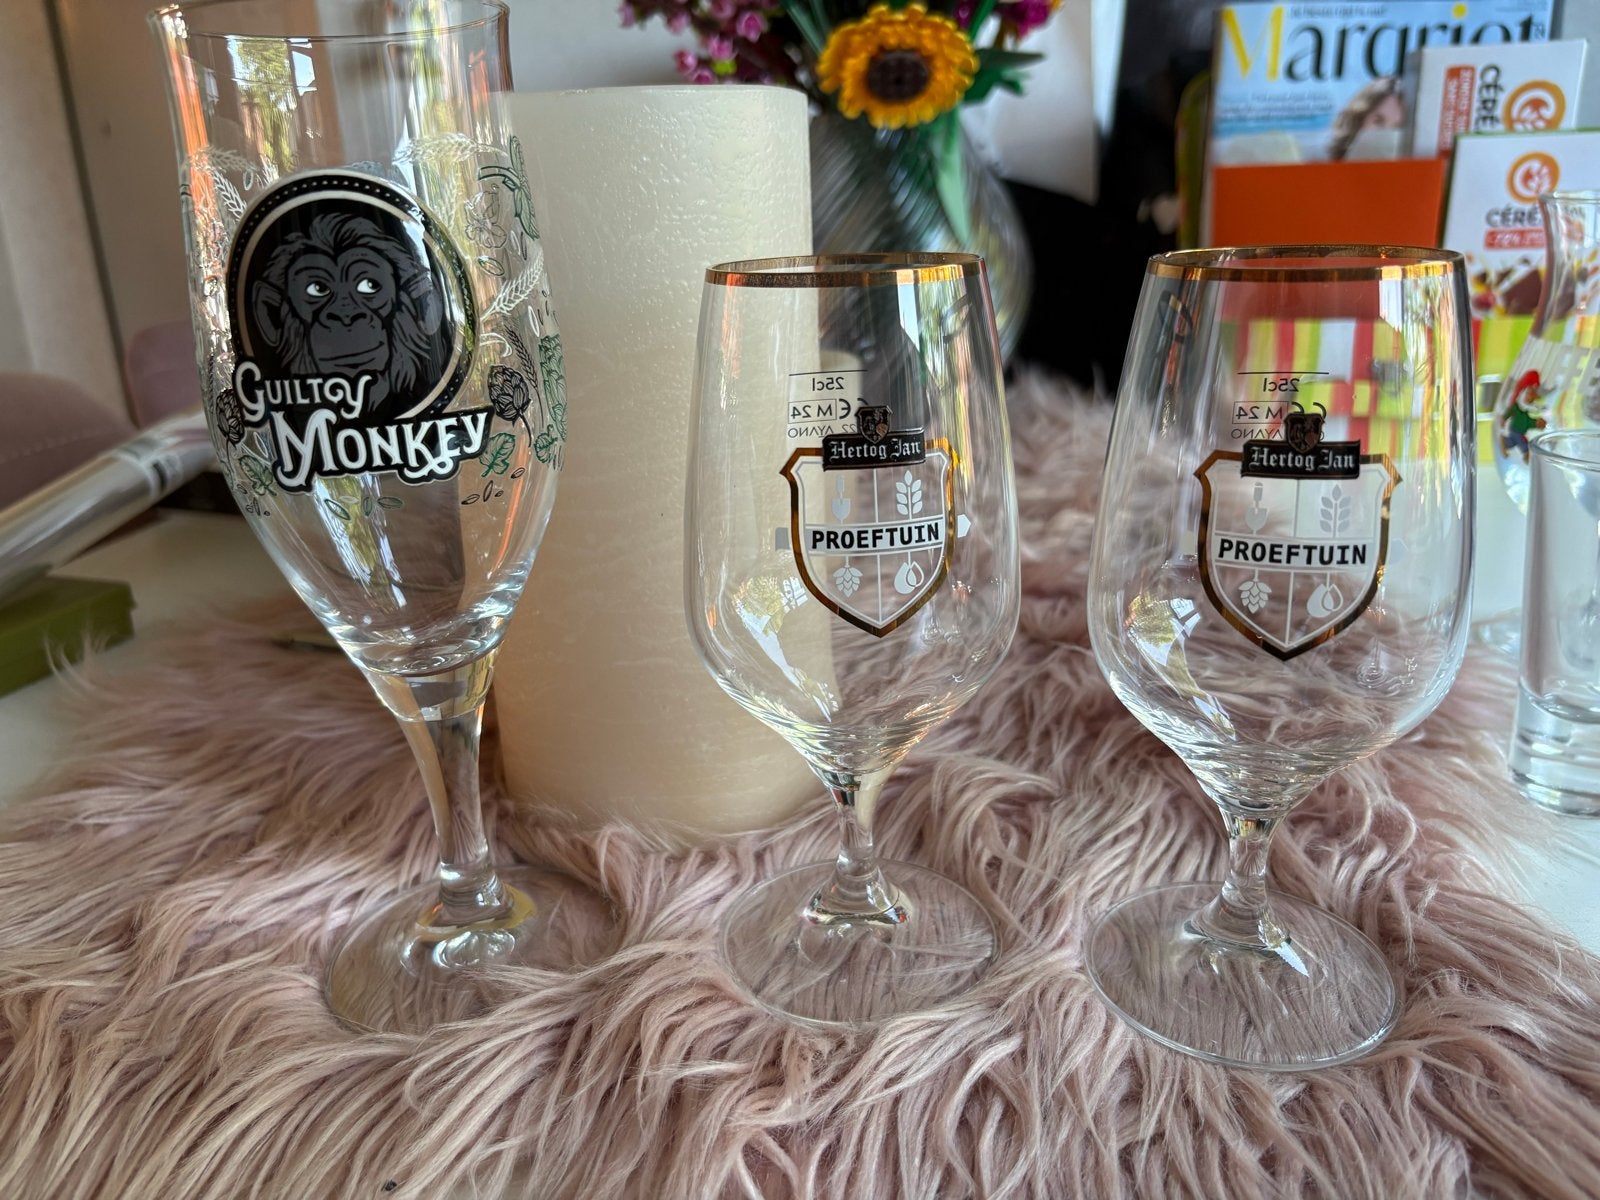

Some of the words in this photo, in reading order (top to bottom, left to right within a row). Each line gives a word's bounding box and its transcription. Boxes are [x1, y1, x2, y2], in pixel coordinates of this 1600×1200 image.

[270, 409, 488, 487] MONKEY
[828, 440, 888, 461] Hertog
[890, 437, 921, 457] Jan
[1249, 446, 1316, 471] Hertog
[1318, 449, 1355, 470] Jan
[811, 522, 939, 549] PROEFTUIN
[1218, 538, 1367, 565] PROEFTUIN
